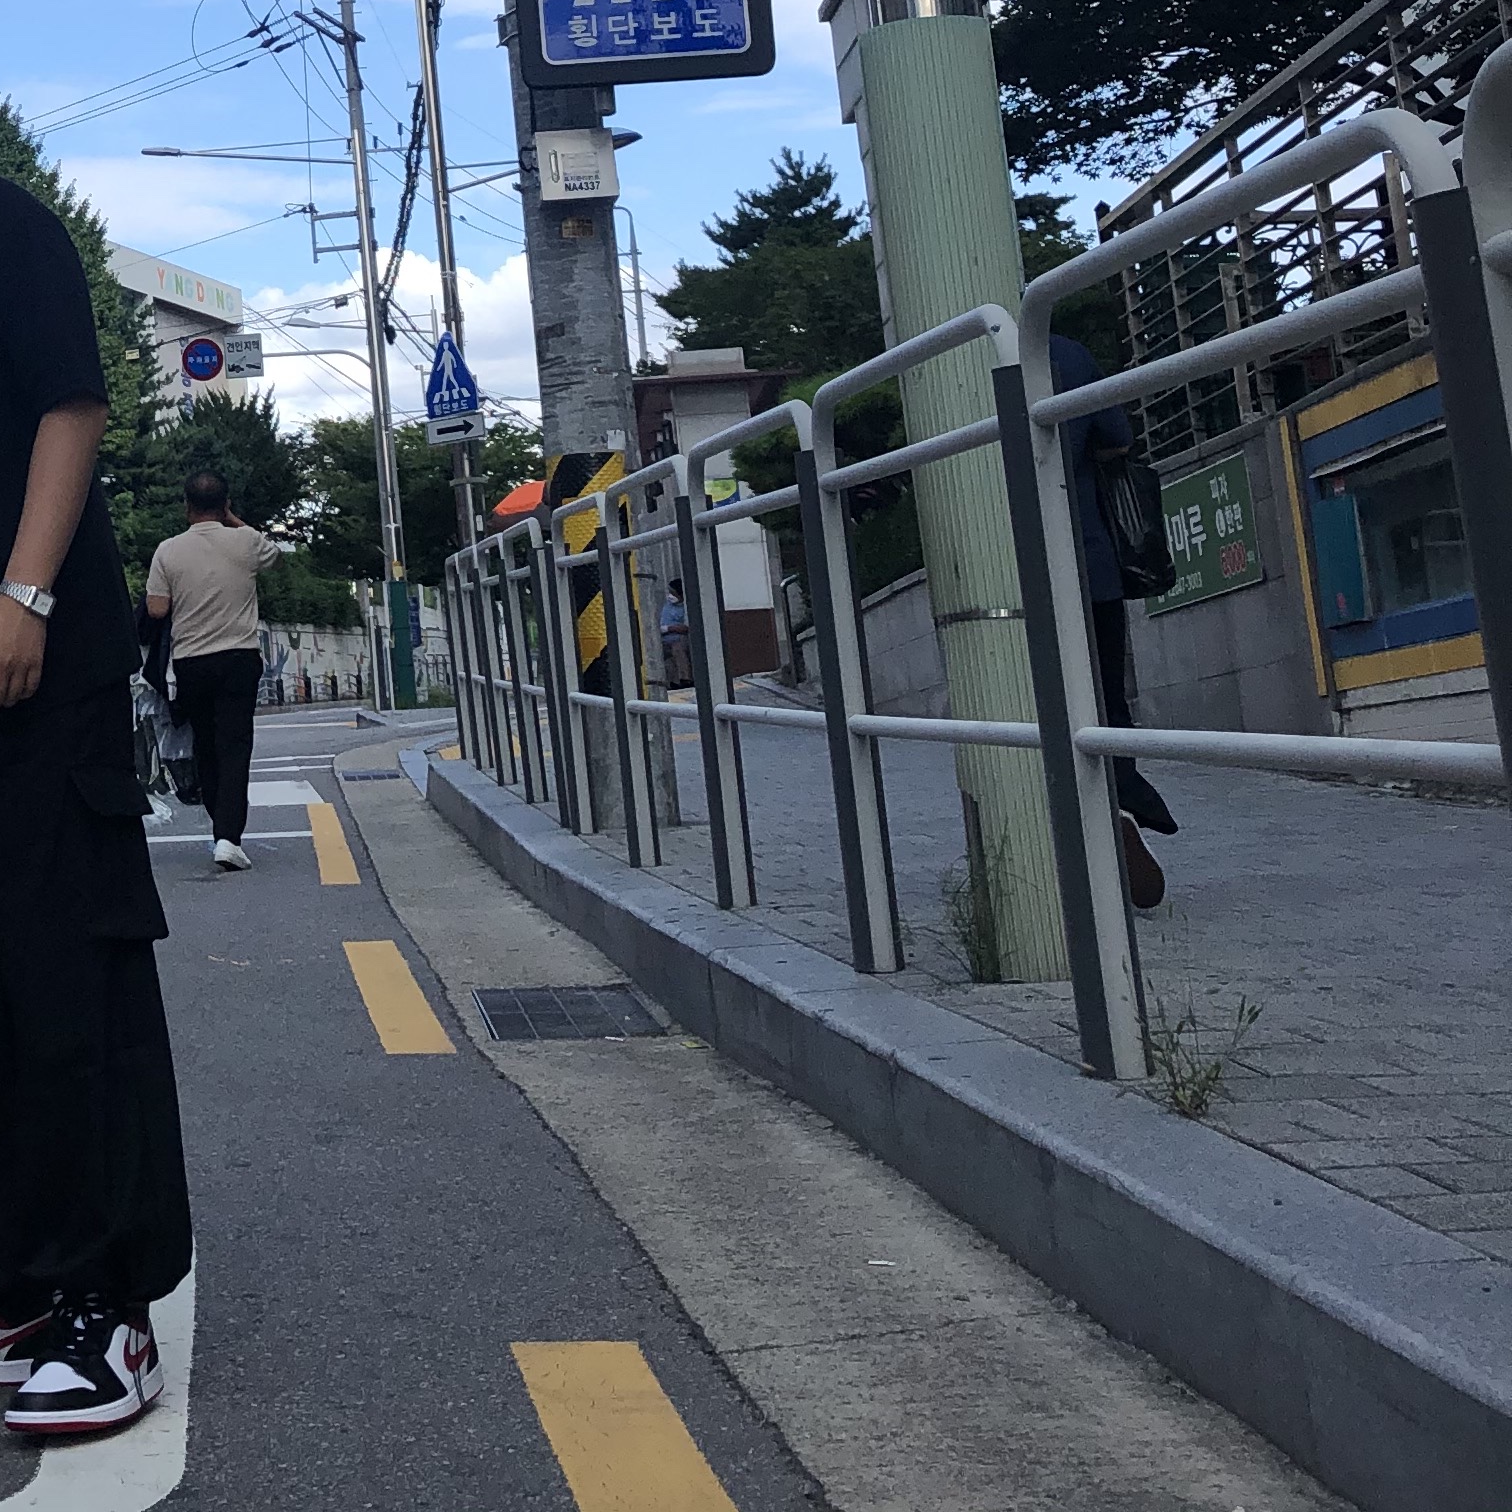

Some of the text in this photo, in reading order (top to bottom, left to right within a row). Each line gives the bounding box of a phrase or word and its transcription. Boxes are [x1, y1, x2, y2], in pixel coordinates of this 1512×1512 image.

[568, 7, 724, 48] 횡단보도
[565, 181, 601, 192] NA4337
[226, 340, 259, 353] 견인지역
